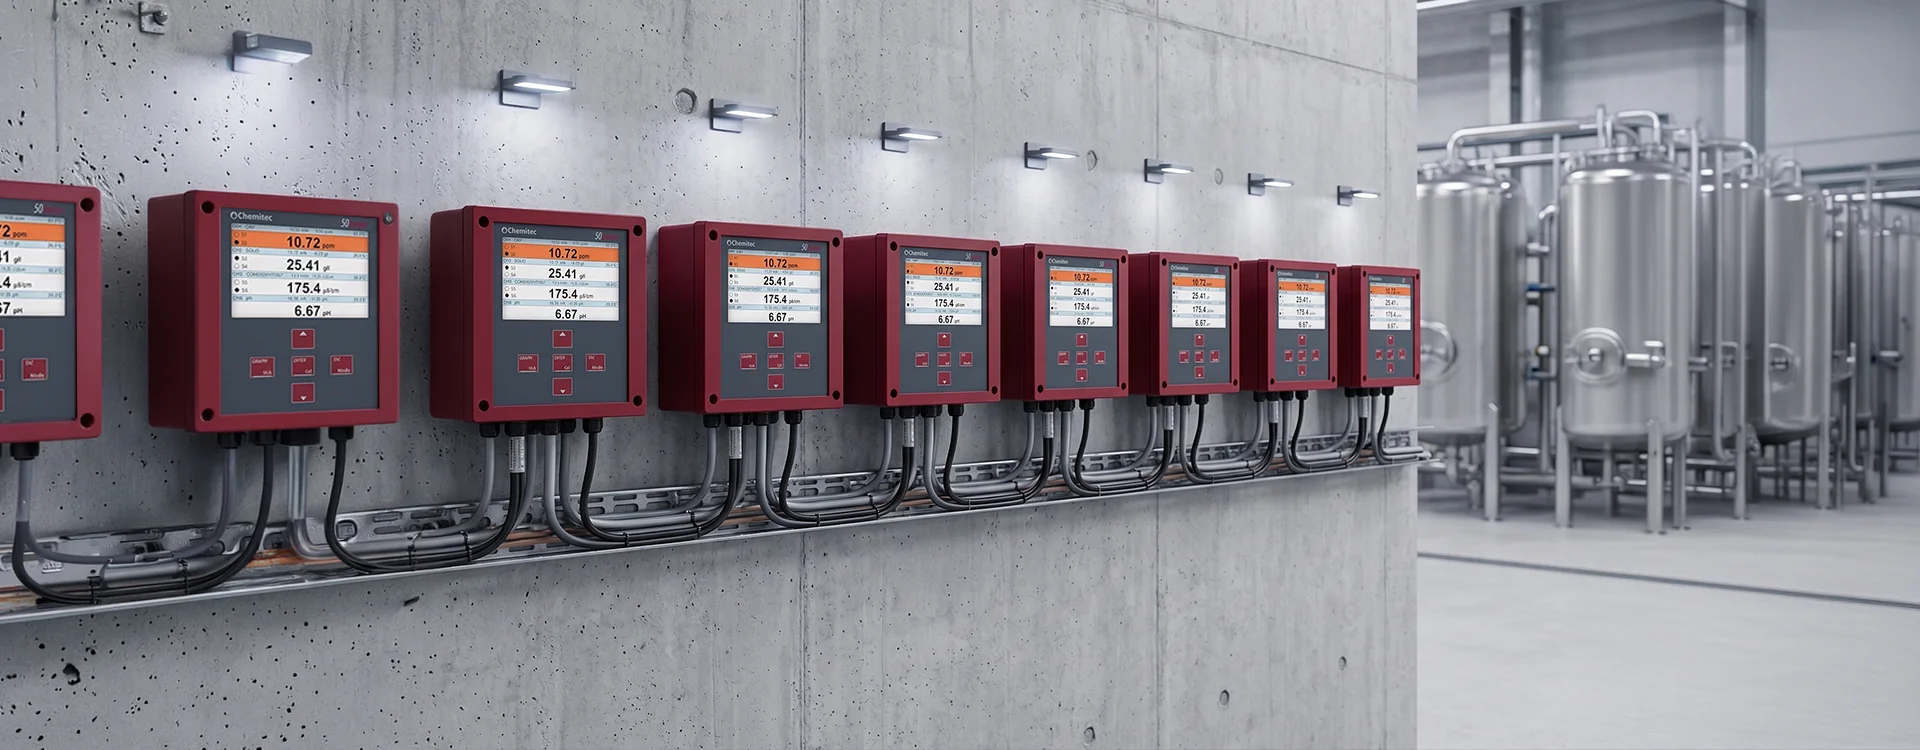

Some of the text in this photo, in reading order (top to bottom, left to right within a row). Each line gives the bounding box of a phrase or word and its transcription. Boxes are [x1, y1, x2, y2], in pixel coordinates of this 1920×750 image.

[237, 212, 272, 222] Chemitec
[341, 218, 349, 228] 50
[507, 227, 537, 235] Chemitec
[595, 232, 602, 240] 50
[287, 236, 320, 248] 10.72
[549, 248, 577, 259] 10.72
[286, 259, 319, 271] 25.41
[764, 258, 787, 268] 10.72
[548, 268, 576, 279] 25.41
[934, 267, 954, 275] 10.72
[763, 276, 786, 286] 25.41
[287, 282, 320, 294] 175.4
[934, 282, 953, 291] 25.41
[549, 288, 578, 299] 175.4
[764, 294, 787, 304] 175.4
[934, 299, 954, 307] 175.4
[294, 305, 320, 317] 6.67
[555, 309, 577, 319] 6.67
[768, 312, 787, 321] 6.67
[938, 315, 954, 324] 6.67
